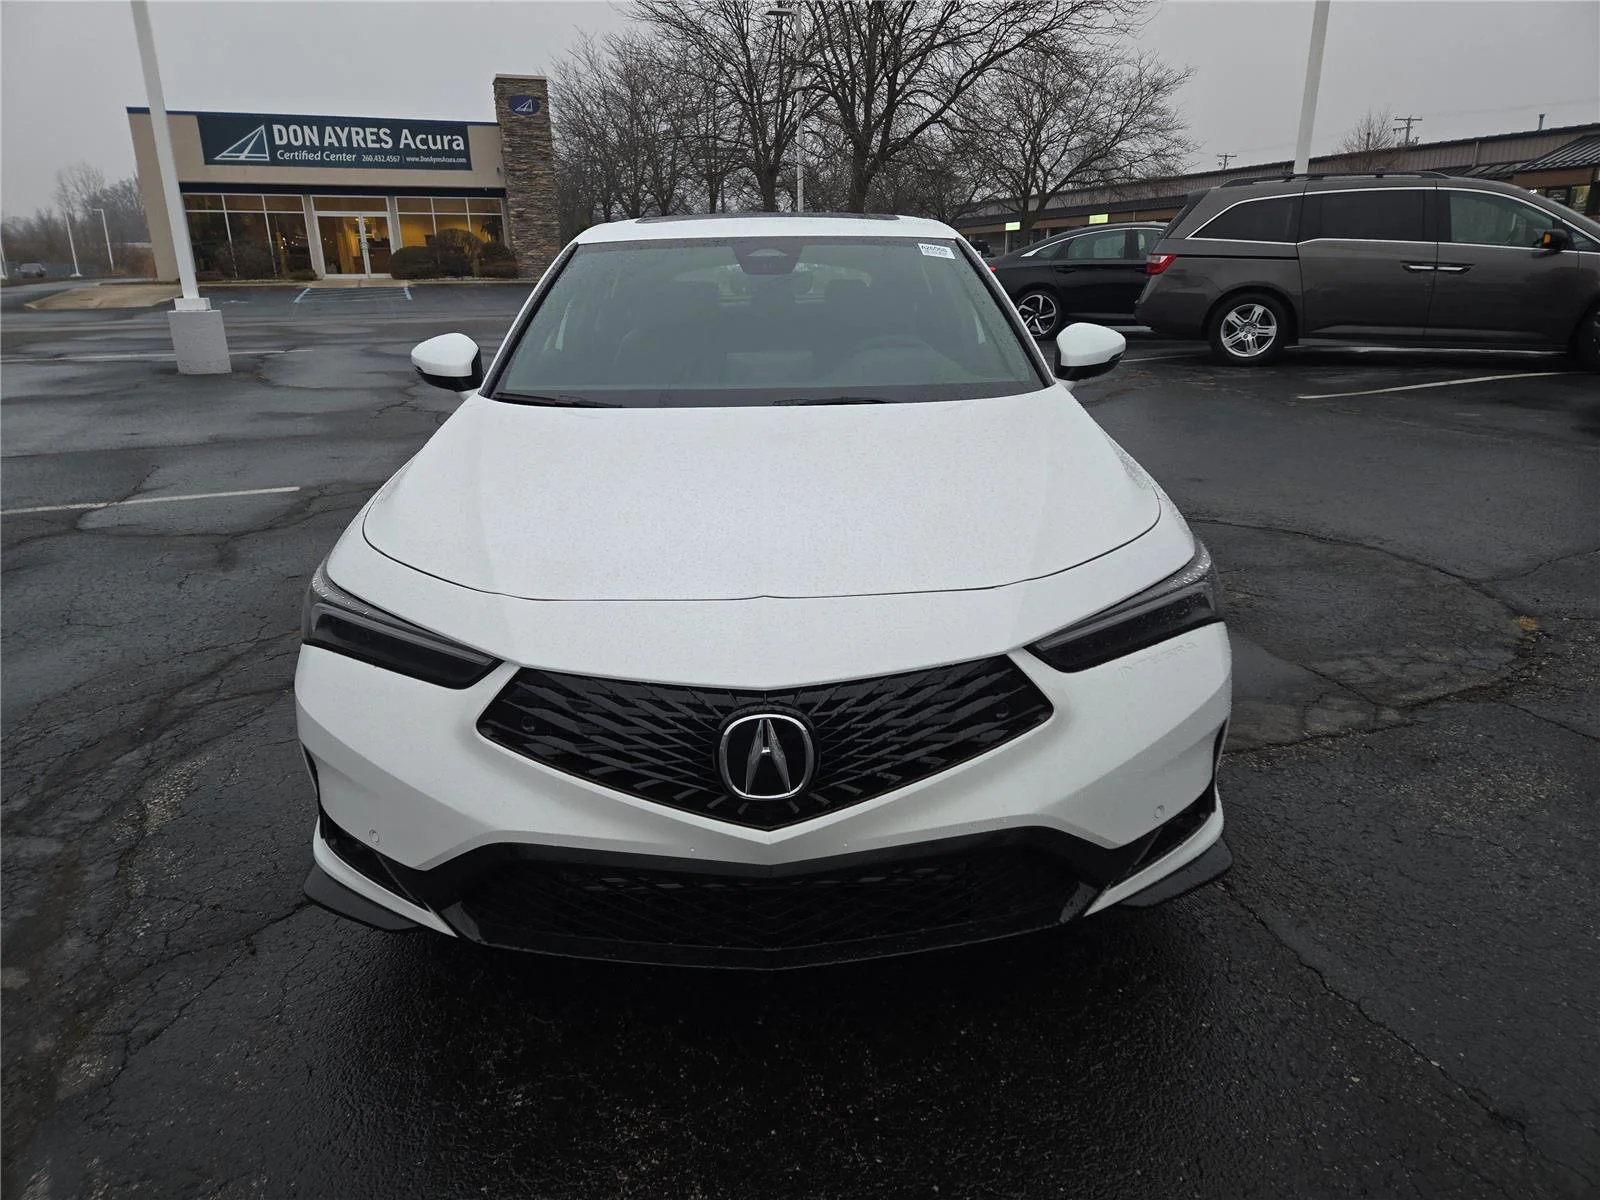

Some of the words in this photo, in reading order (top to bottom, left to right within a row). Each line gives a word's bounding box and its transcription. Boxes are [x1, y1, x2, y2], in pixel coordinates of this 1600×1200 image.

[272, 124, 319, 147] DON
[323, 126, 393, 149] AYRES
[399, 128, 465, 151] Acura
[276, 149, 321, 160] Certified
[322, 151, 357, 162] Center
[361, 154, 400, 163] 260.432.4567
